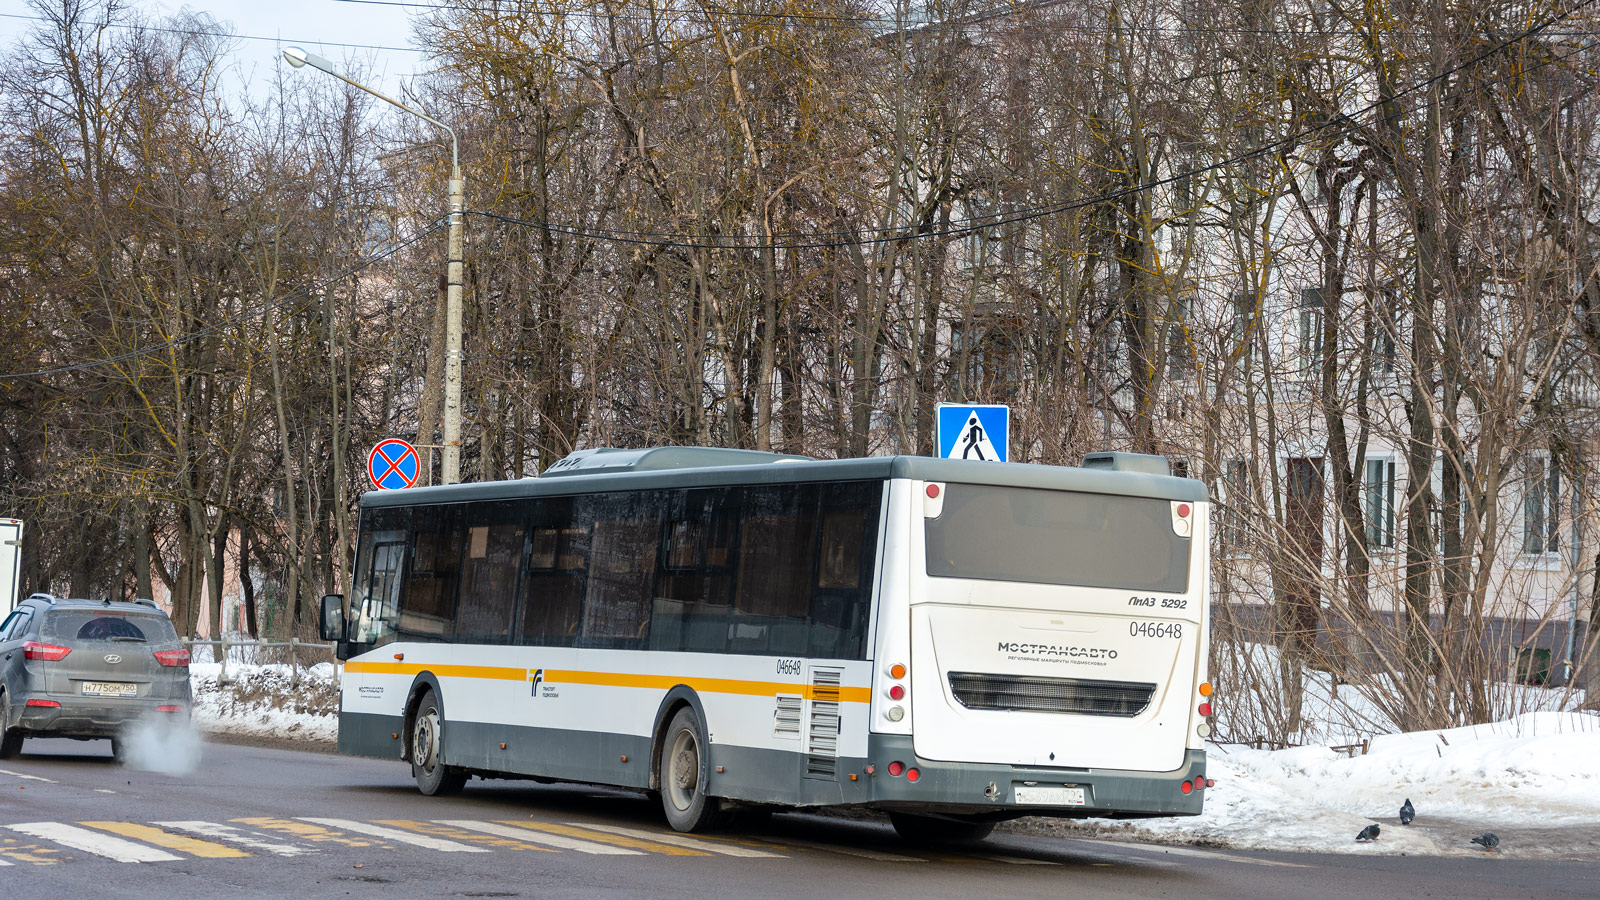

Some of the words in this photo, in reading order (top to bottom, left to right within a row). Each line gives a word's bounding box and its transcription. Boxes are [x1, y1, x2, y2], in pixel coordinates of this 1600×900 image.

[1161, 598, 1188, 610] 5292
[1129, 621, 1182, 639] 046648
[998, 642, 1118, 659] МОСТРАНСАВТО
[776, 659, 801, 675] 046648
